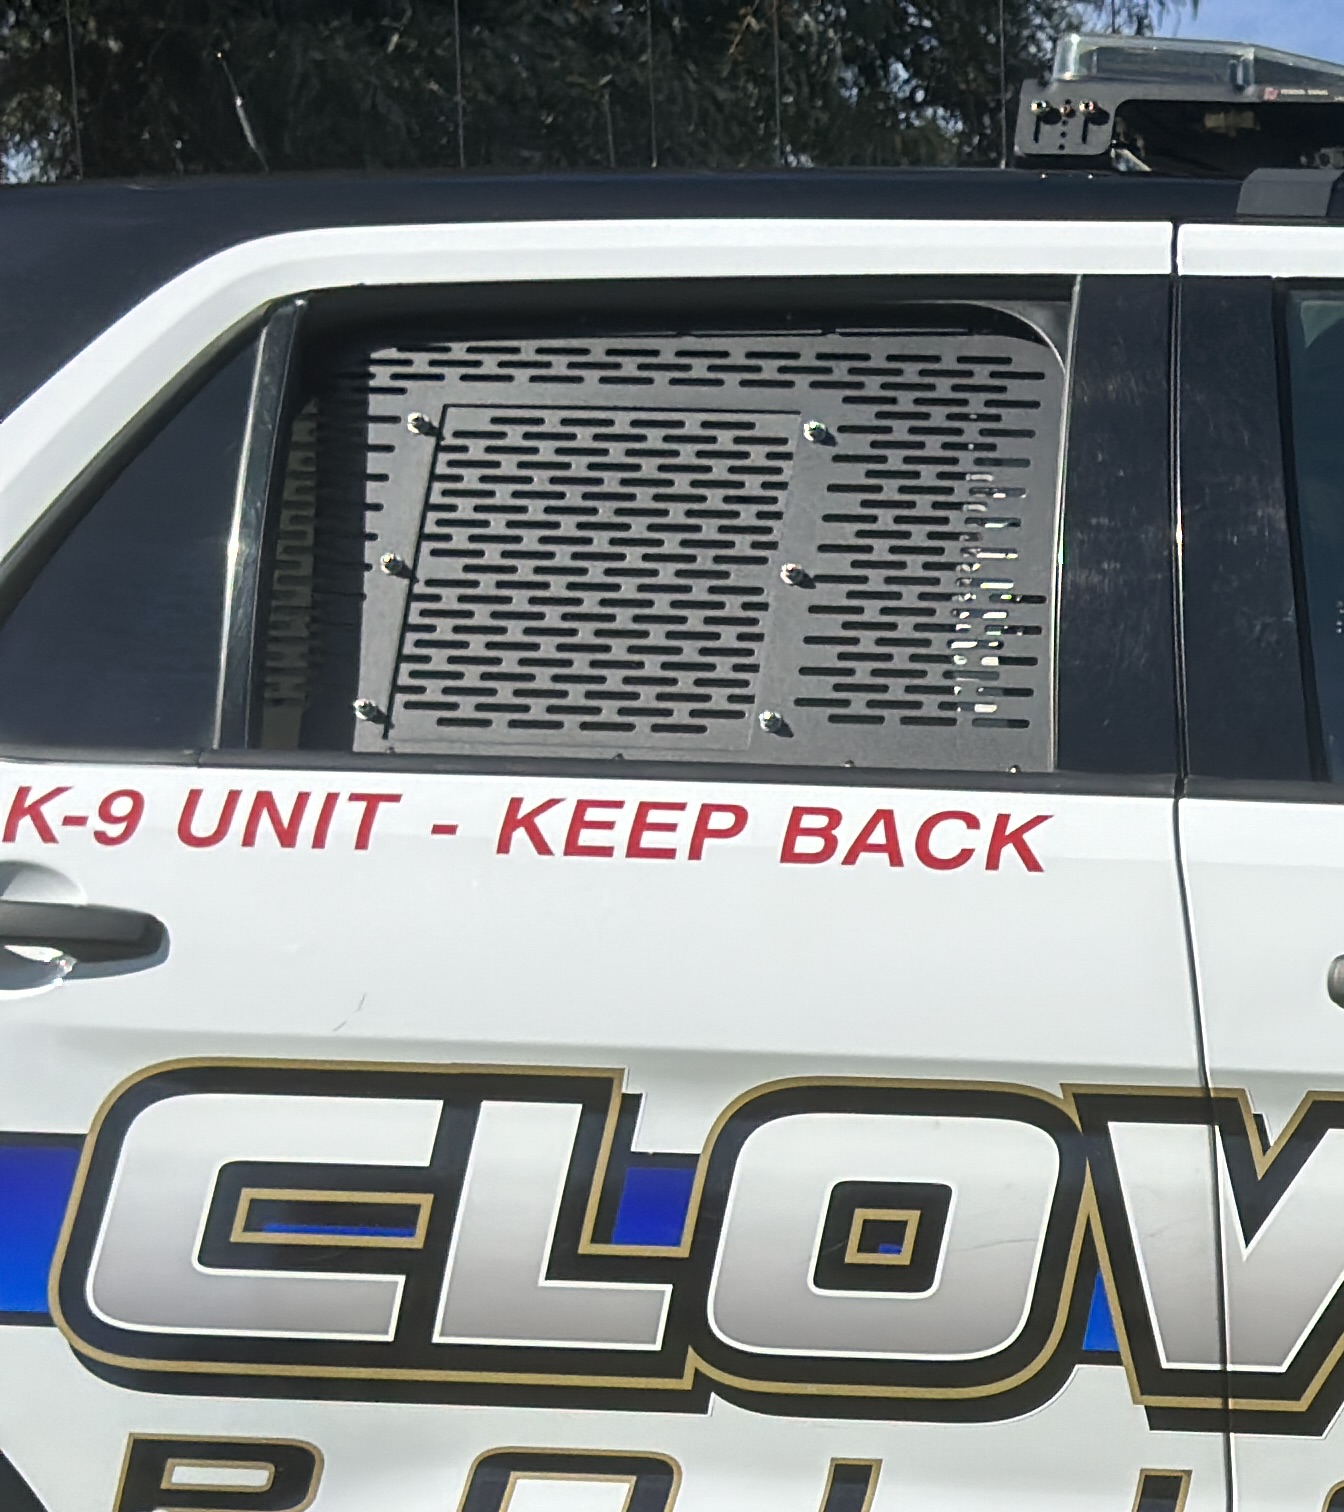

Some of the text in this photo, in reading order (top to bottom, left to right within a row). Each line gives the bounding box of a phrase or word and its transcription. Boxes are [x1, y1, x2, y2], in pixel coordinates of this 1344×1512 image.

[2, 785, 147, 847] K-9
[177, 788, 403, 851] UNIT
[495, 797, 749, 861] KEEP
[779, 806, 1053, 873] BACK
